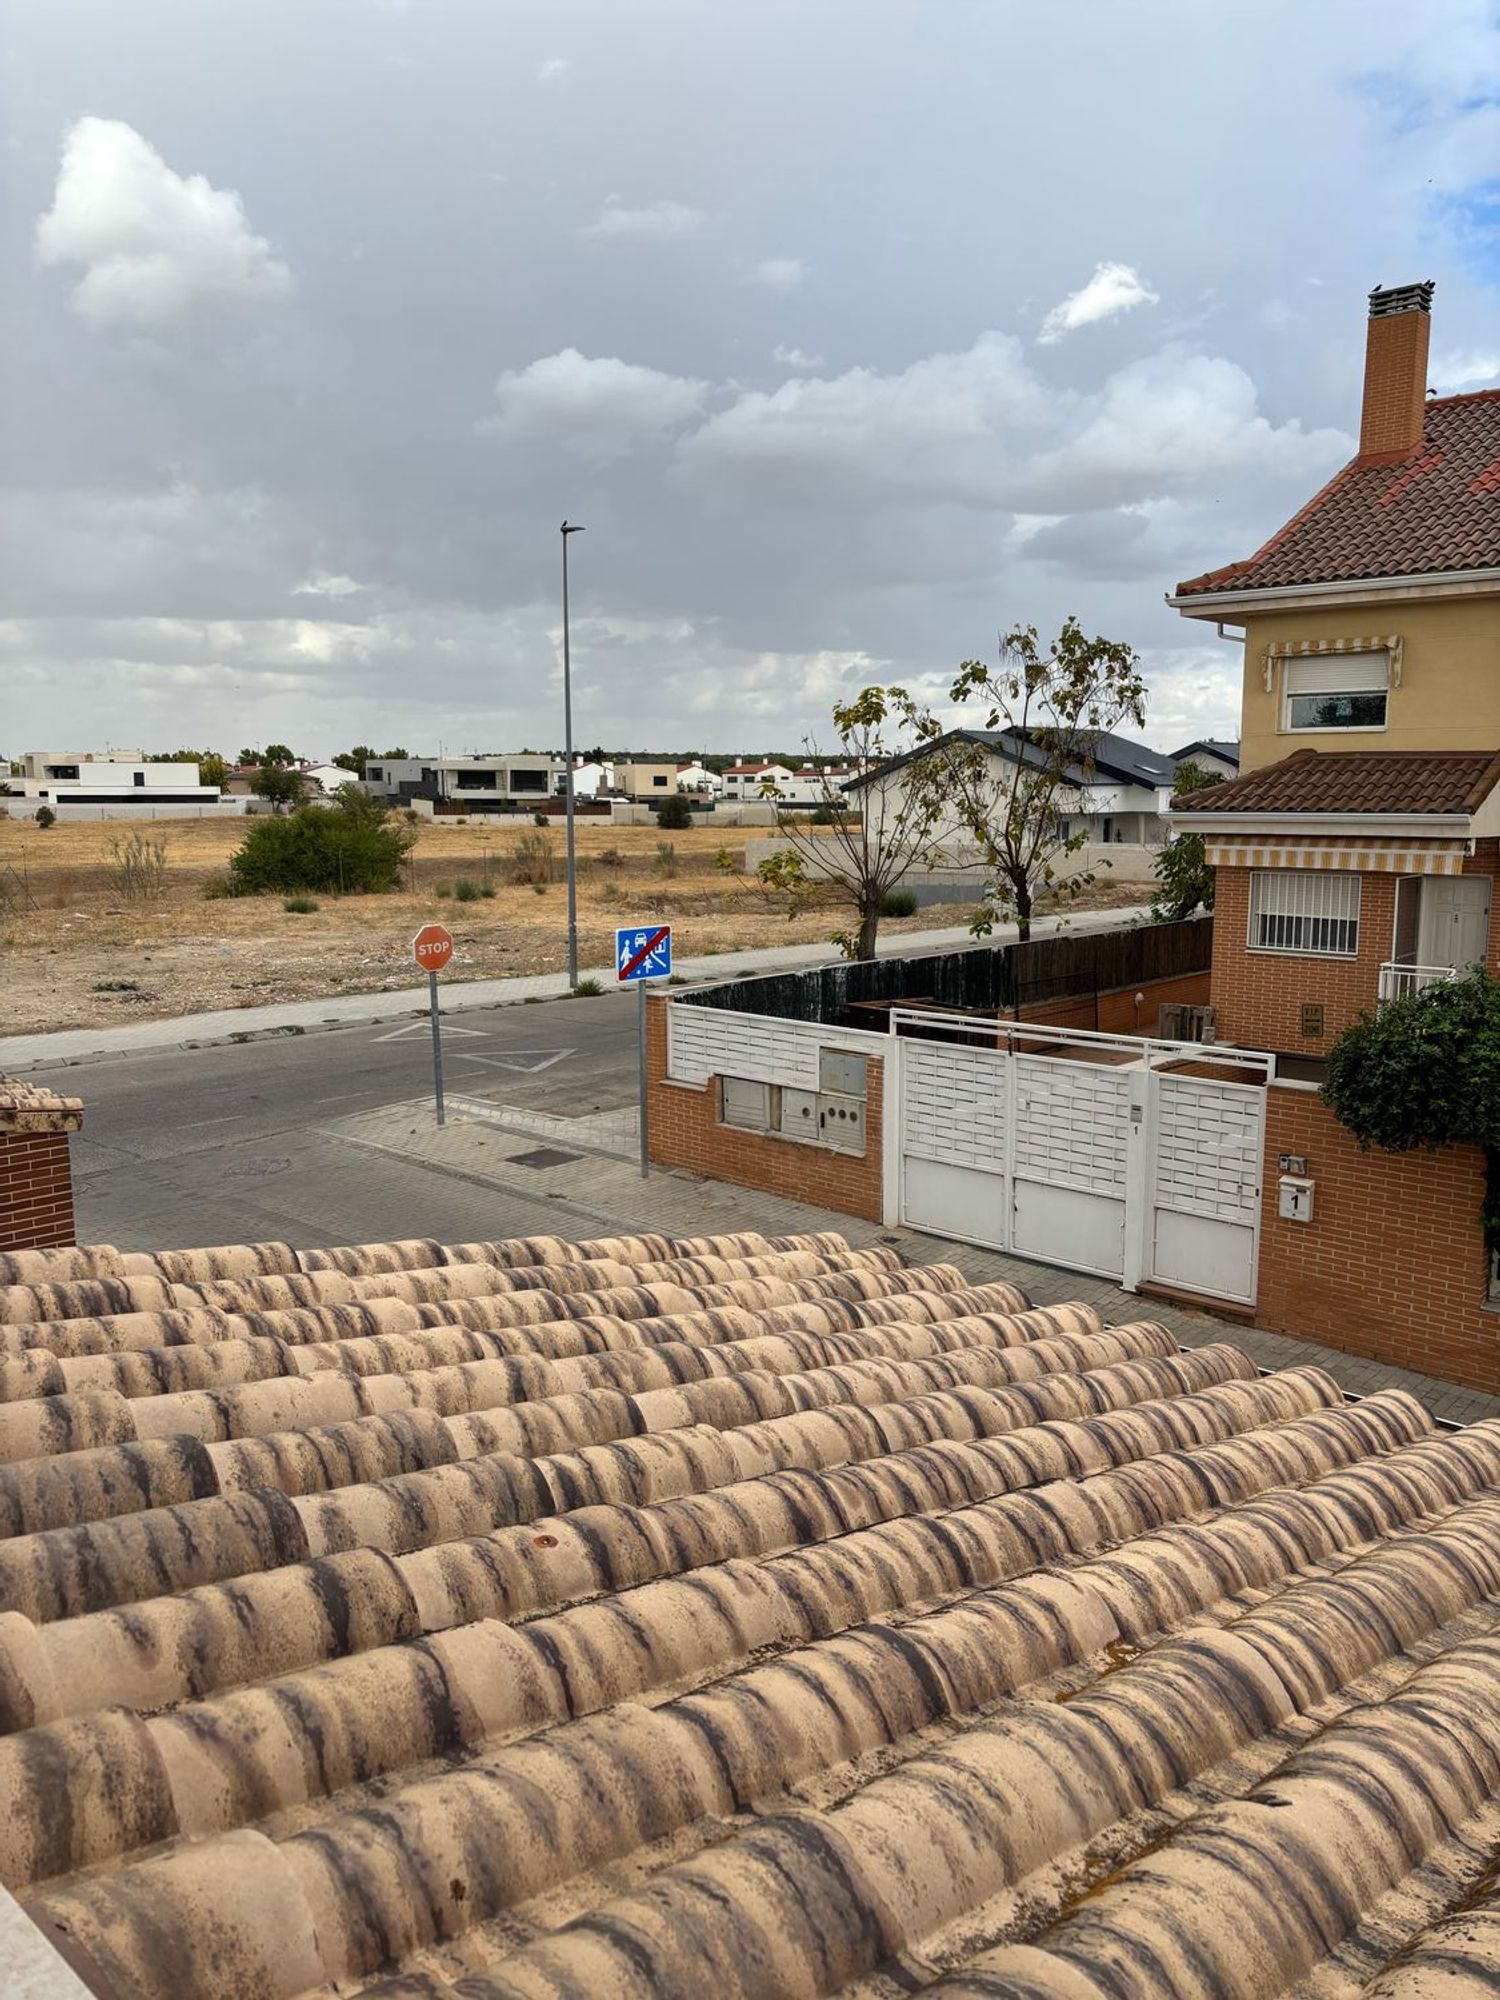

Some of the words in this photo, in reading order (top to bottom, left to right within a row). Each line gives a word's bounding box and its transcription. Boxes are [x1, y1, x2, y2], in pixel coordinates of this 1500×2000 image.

[418, 941, 450, 955] STOP
[1133, 1125, 1139, 1136] 1
[1290, 1194, 1299, 1210] 1
